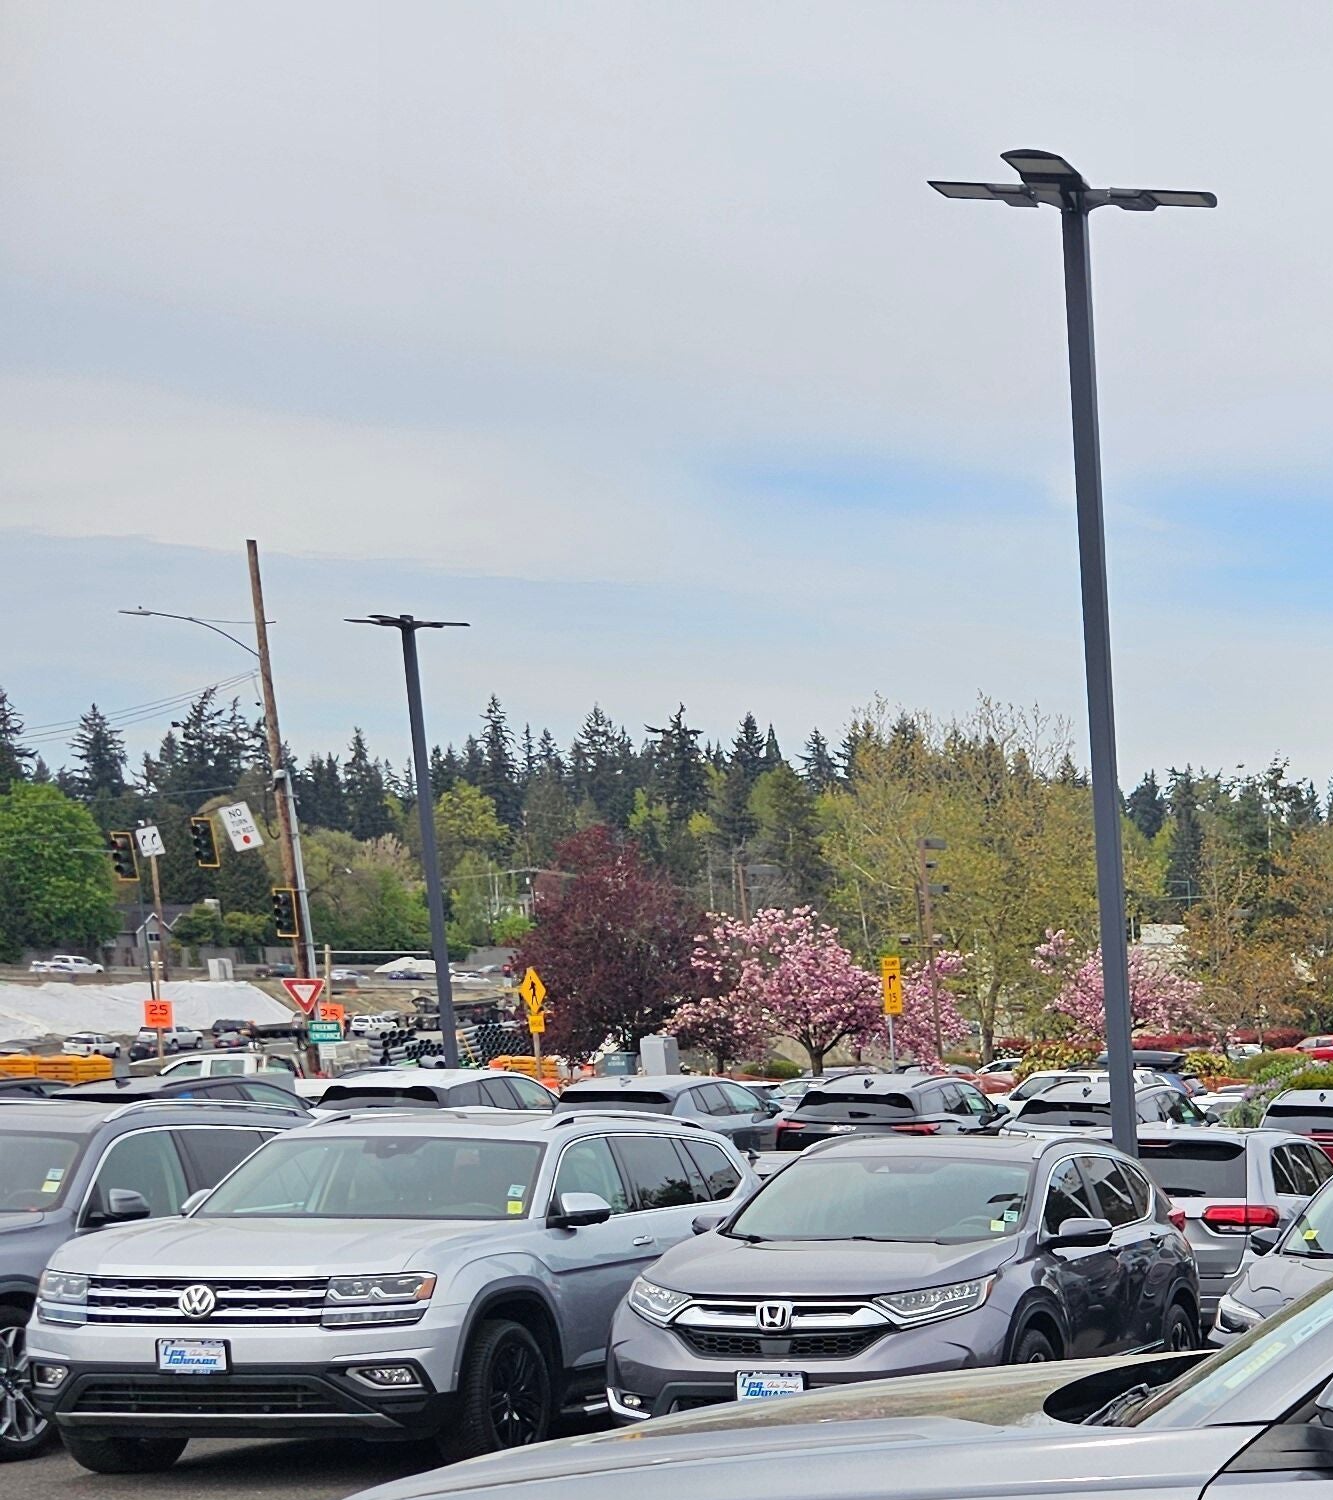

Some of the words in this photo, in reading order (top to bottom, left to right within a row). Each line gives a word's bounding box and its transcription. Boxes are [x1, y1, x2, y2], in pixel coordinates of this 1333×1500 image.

[229, 808, 241, 817] NO
[149, 1004, 168, 1016] 25
[164, 1345, 186, 1356] Lee
[742, 1378, 763, 1388] Lee
